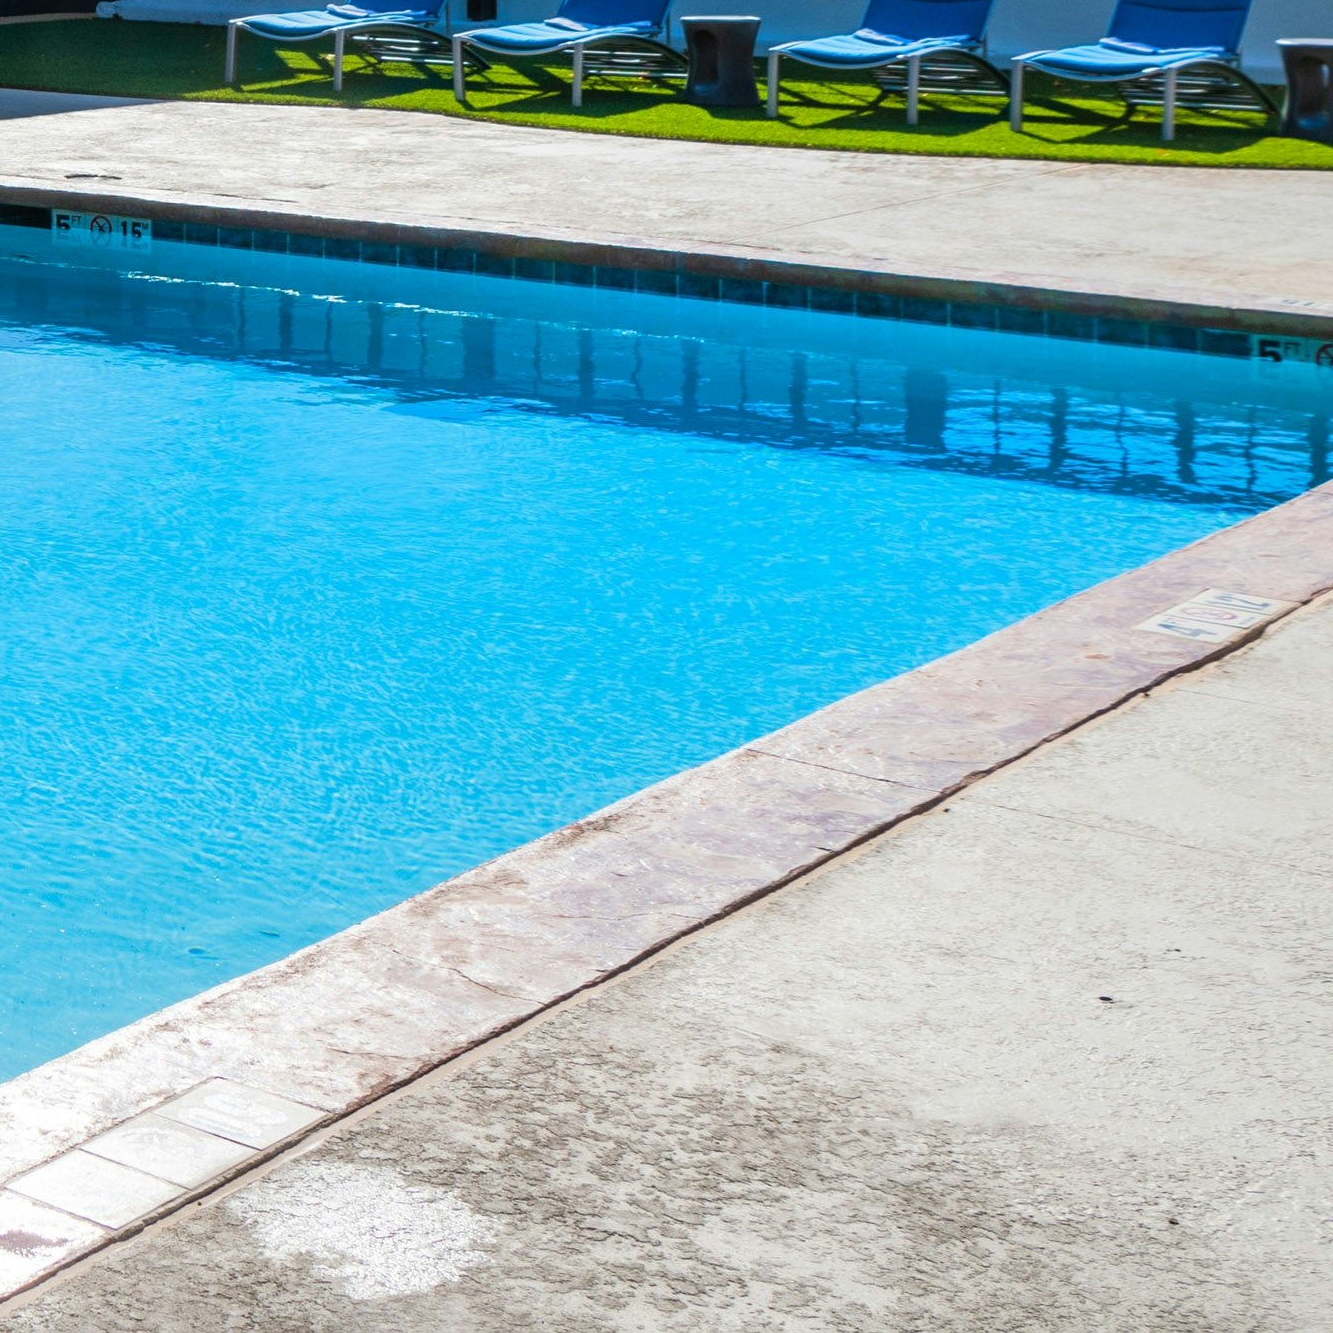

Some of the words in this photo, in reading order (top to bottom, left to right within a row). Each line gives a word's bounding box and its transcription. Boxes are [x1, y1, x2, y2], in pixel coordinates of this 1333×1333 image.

[56, 214, 71, 230] 5
[120, 220, 142, 237] 15
[1259, 340, 1282, 363] 5
